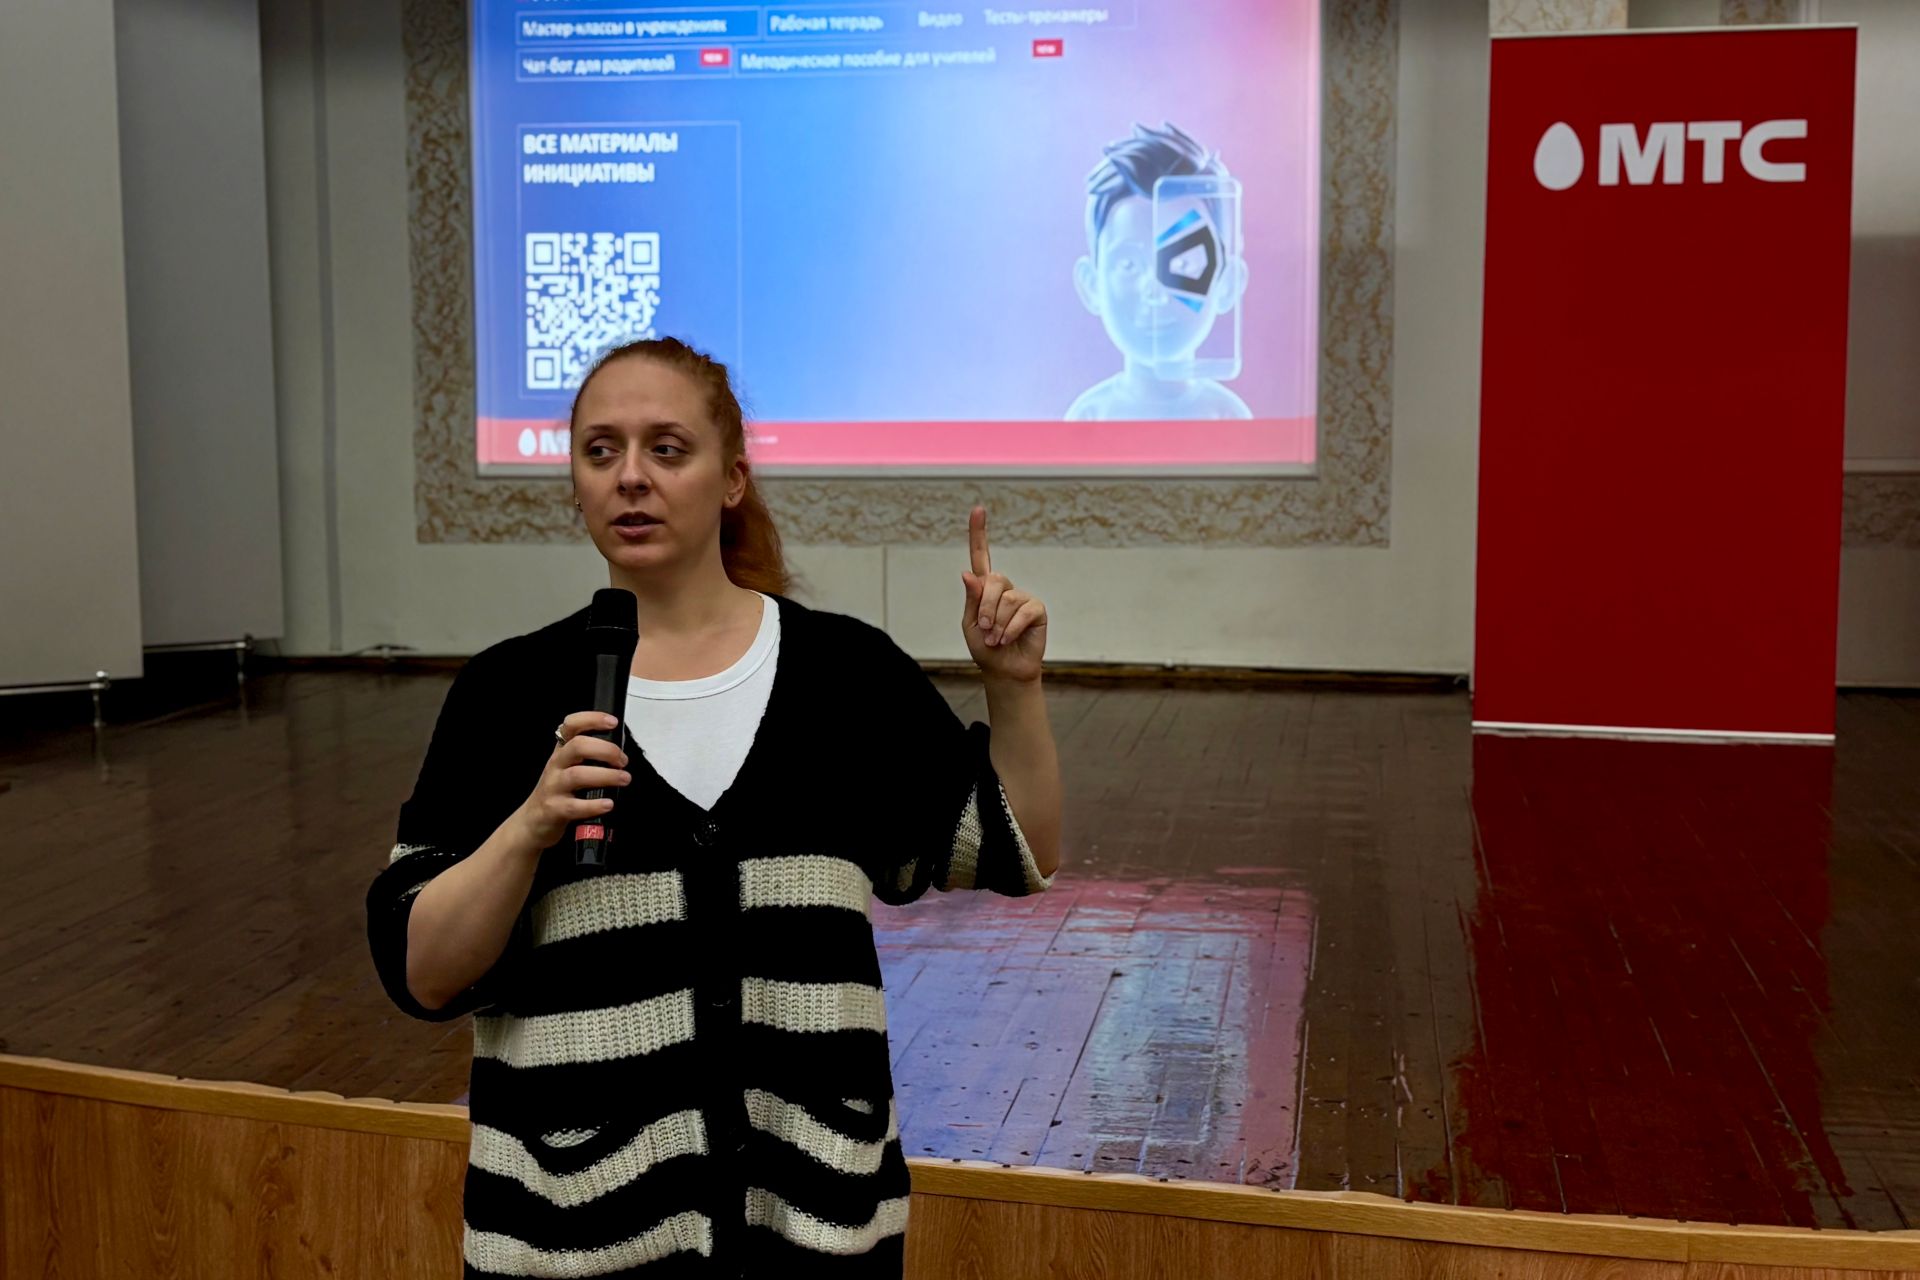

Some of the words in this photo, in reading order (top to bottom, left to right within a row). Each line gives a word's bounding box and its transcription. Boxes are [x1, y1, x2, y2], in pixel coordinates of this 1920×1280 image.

[636, 18, 728, 37] учреждениях
[769, 14, 828, 33] Рабочая
[829, 15, 884, 32] тетрадь
[917, 10, 964, 29] Видео
[574, 57, 602, 75] для
[601, 53, 676, 75] родителей
[740, 52, 842, 71] Методическое
[842, 48, 902, 68] пособие
[902, 51, 931, 68] для
[932, 47, 996, 68] учителей
[523, 133, 558, 155] ВСЕ
[560, 131, 678, 154] МАТЕРИАЛЫ
[1598, 118, 1808, 187] МТС
[523, 162, 655, 188] ИНИЦИАТИВЫ
